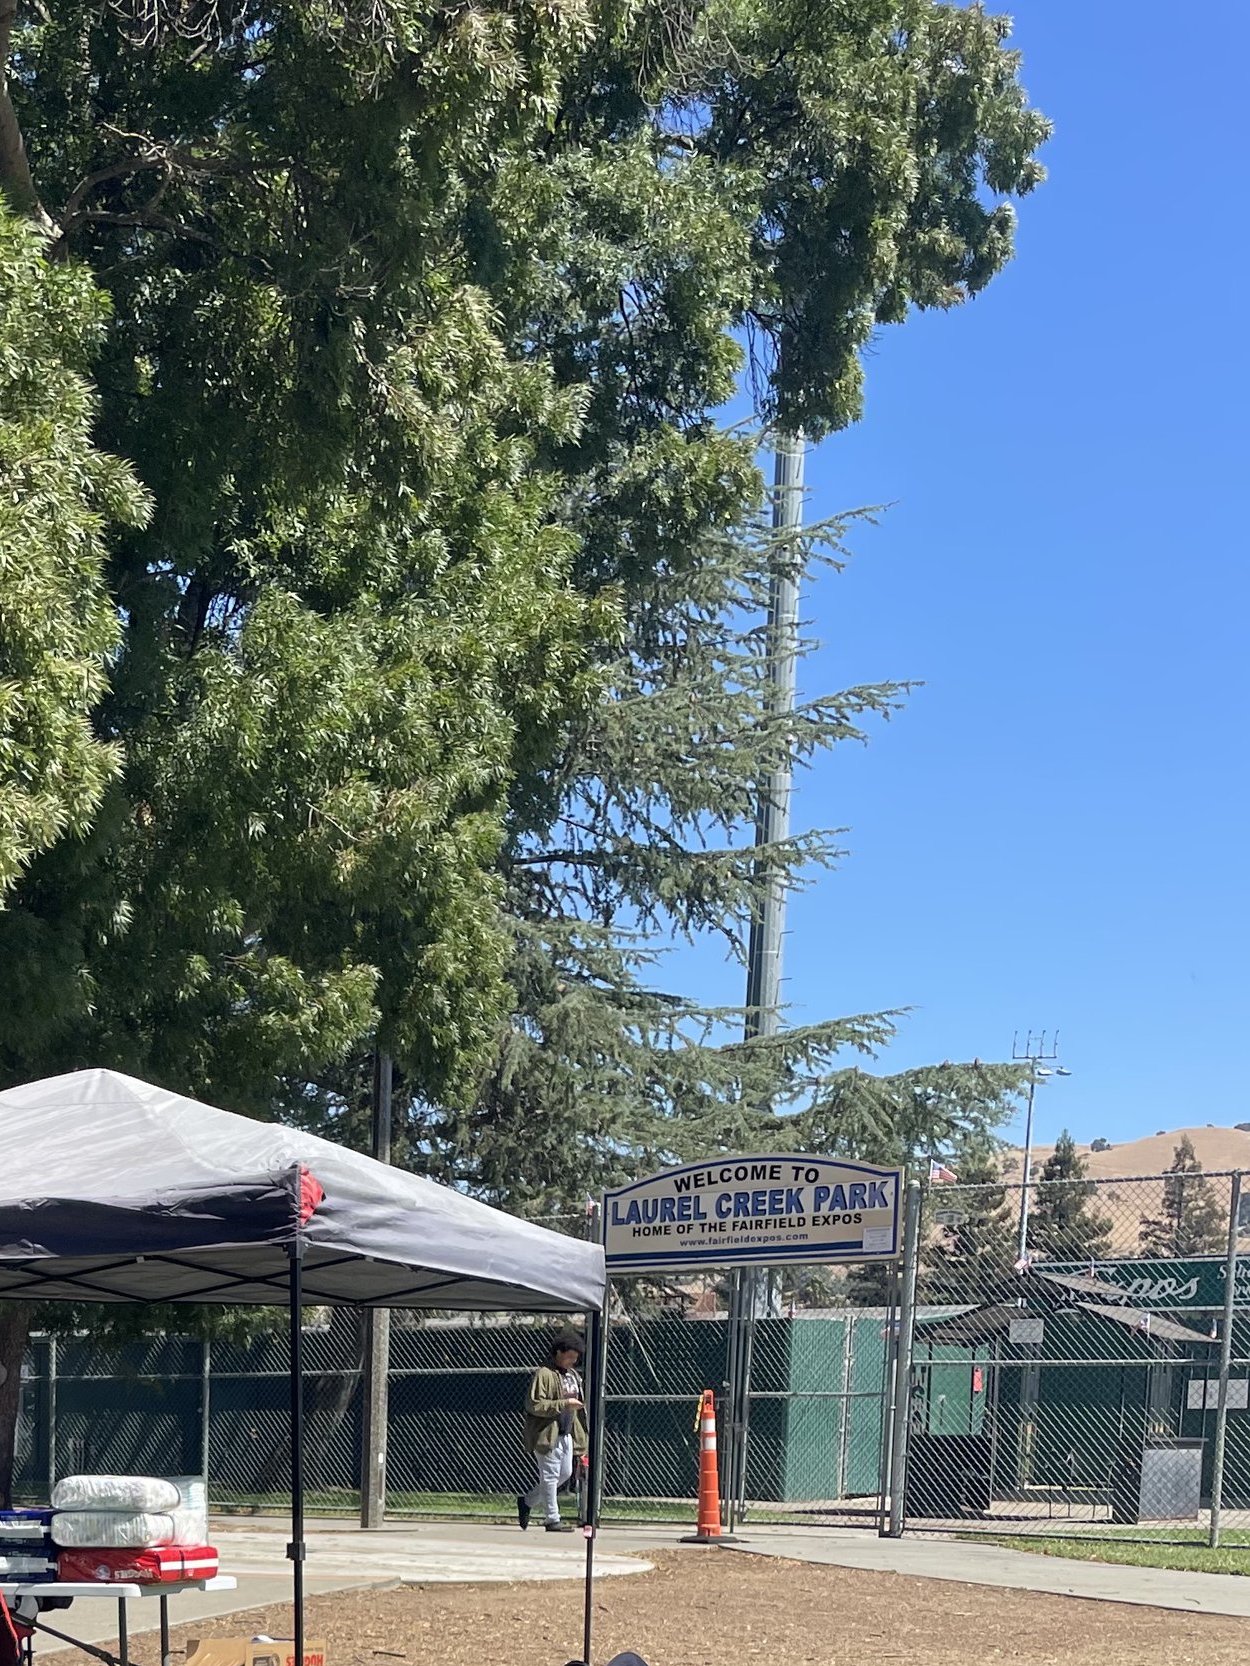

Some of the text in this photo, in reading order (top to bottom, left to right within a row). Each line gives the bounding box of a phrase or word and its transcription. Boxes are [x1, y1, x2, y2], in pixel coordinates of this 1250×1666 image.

[673, 1165, 820, 1193] WELCOME TO
[611, 1180, 890, 1226] LAUREL CREEK PARK
[632, 1213, 863, 1238] HOME OF THE FAIRFIELD EXPOS
[679, 1231, 810, 1248] www.fairfieldexpos.com
